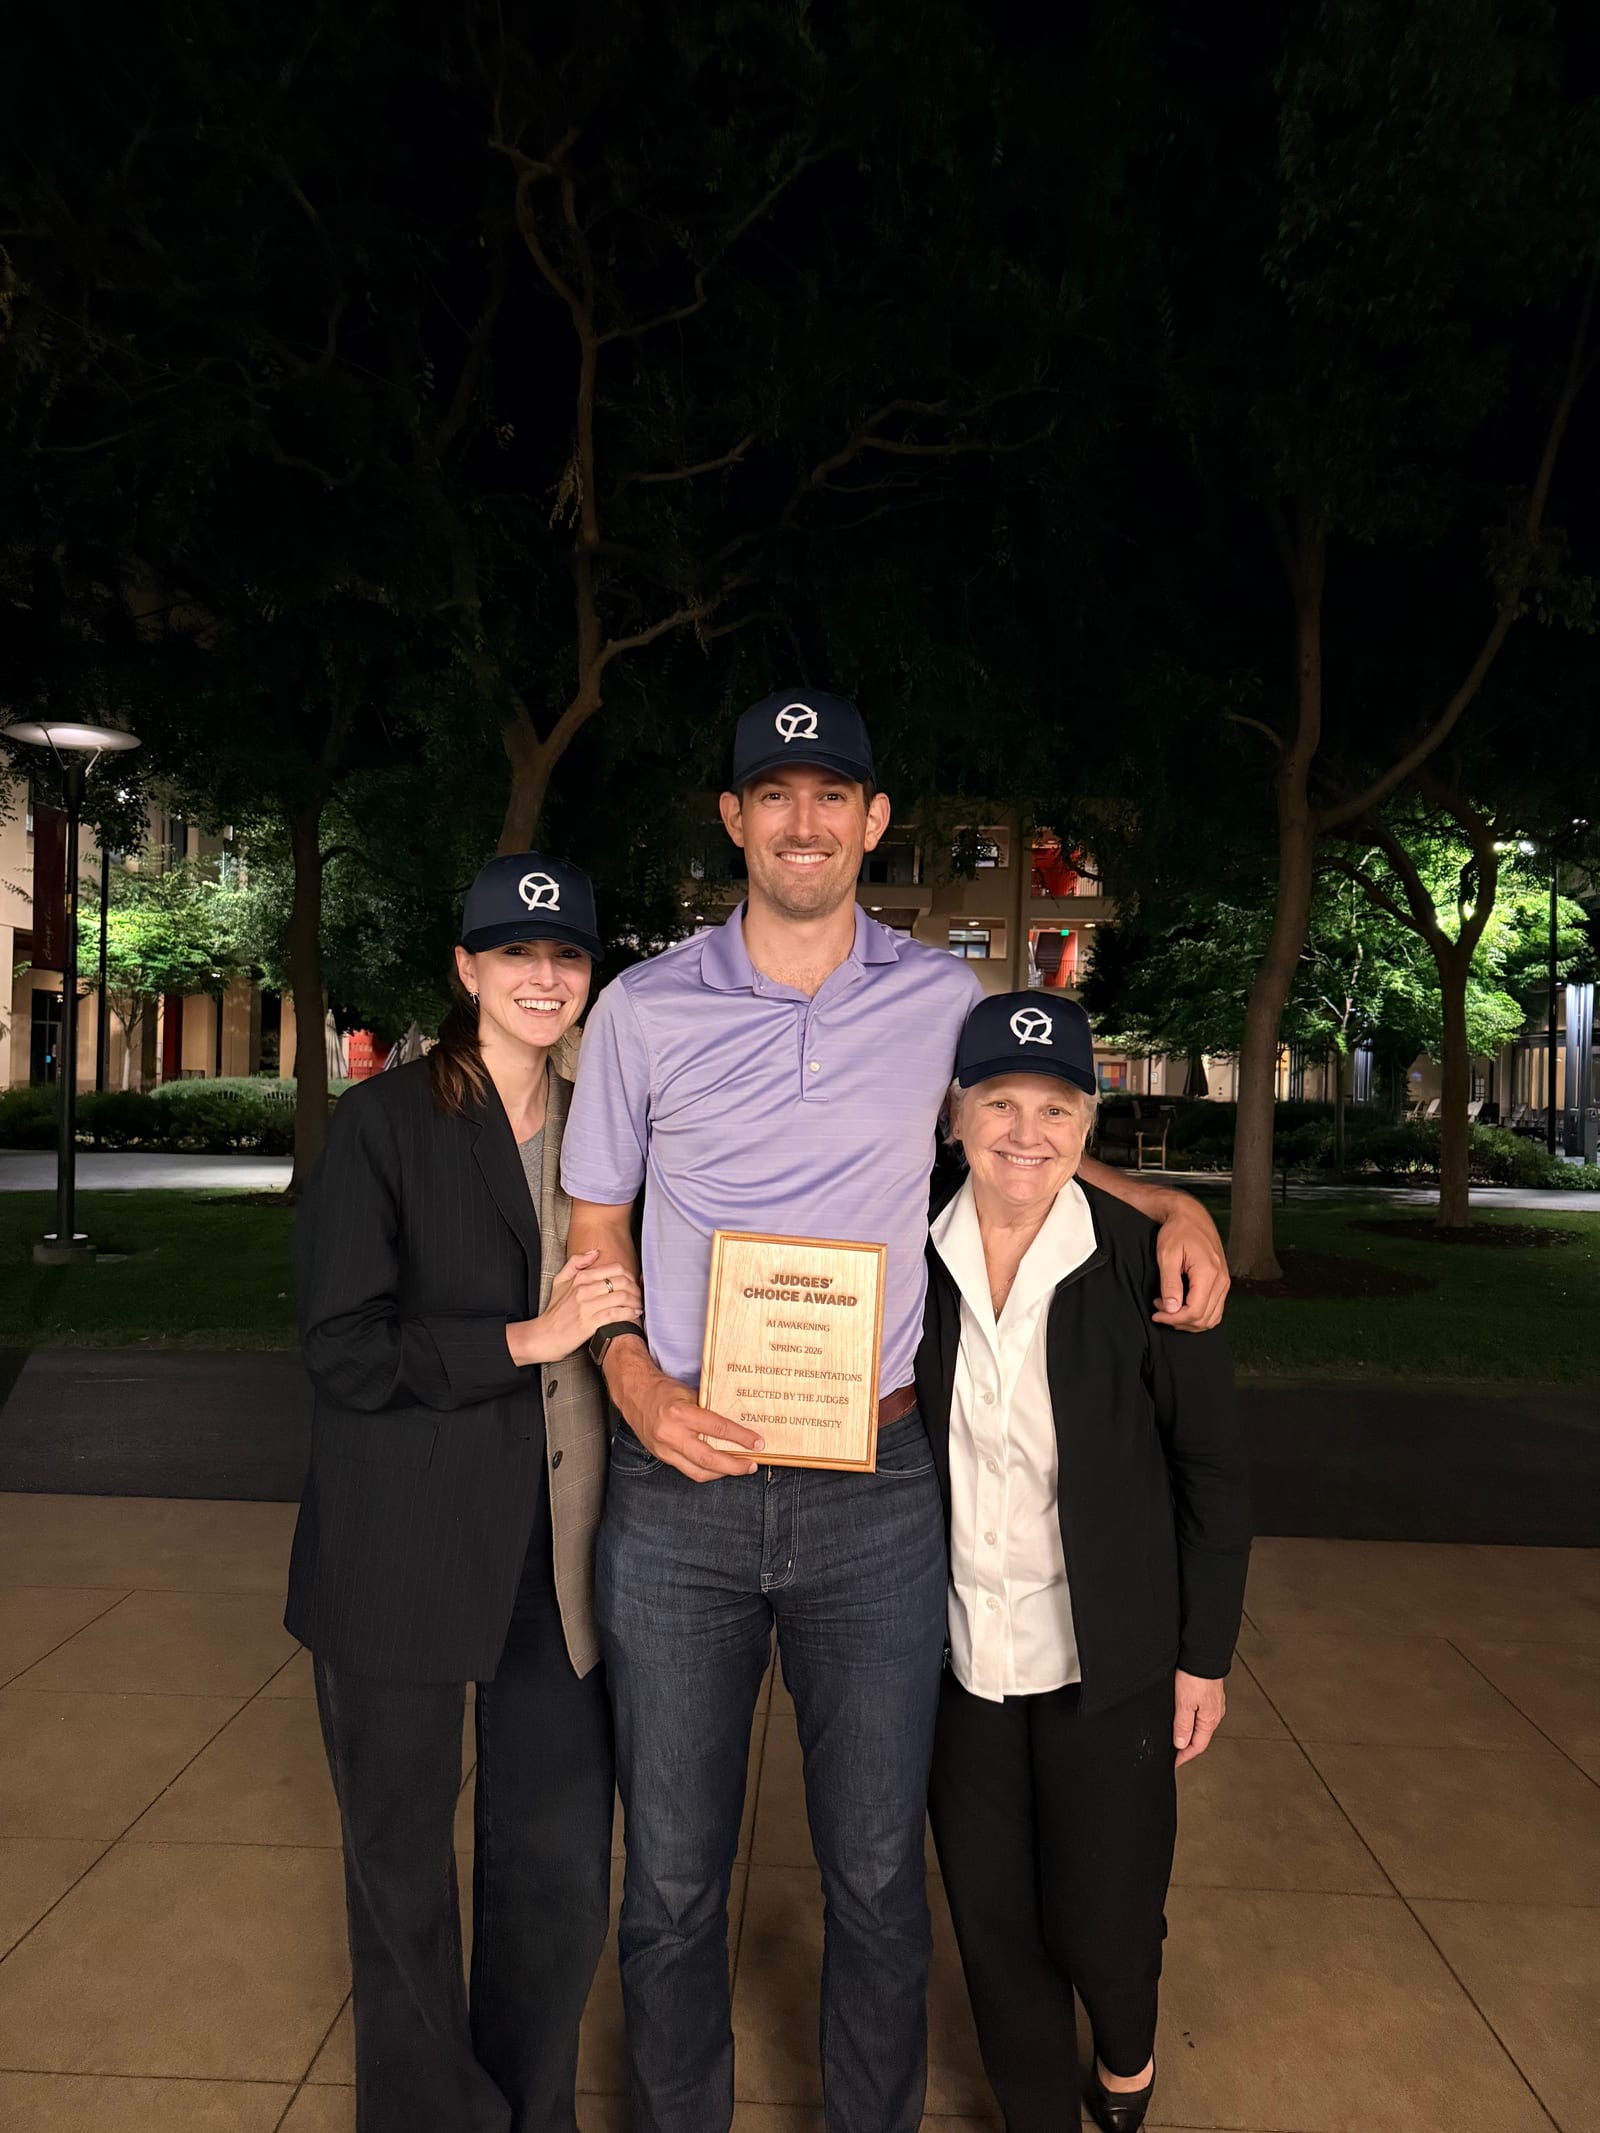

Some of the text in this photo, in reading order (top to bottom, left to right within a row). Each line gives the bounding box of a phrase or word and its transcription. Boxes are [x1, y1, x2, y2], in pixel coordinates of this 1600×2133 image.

[743, 1287, 857, 1307] CHOICE AWARD
[766, 1320, 830, 1332] AI AWAKENING
[770, 1343, 823, 1355] SPRING 2026
[727, 1363, 862, 1383] FINAL PROJECT PRESENTATIONS
[736, 1388, 849, 1405] SELECTED BY THE JUDGES
[740, 1412, 842, 1429] STANFORD UNIVERSITY
